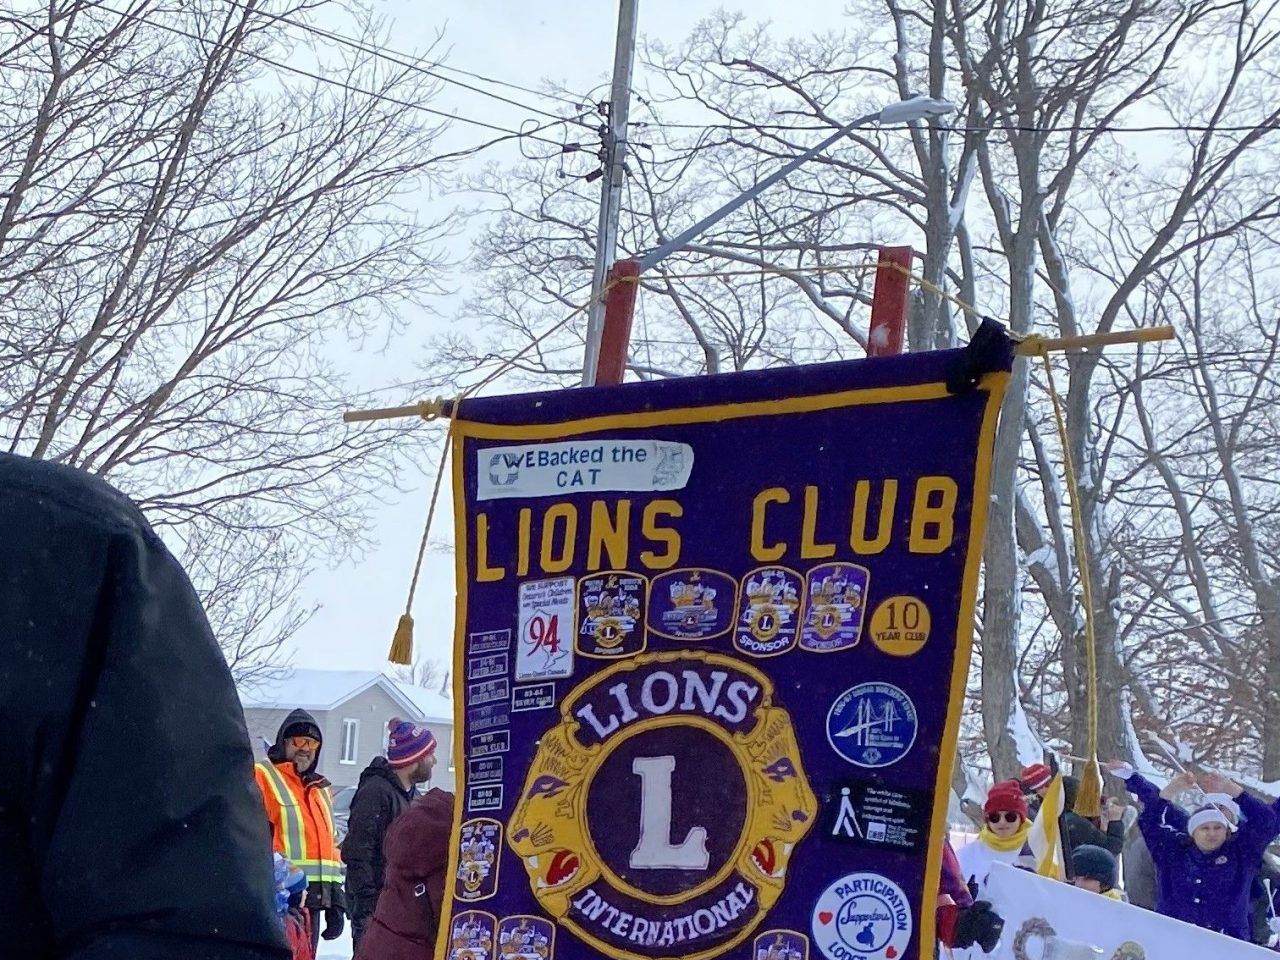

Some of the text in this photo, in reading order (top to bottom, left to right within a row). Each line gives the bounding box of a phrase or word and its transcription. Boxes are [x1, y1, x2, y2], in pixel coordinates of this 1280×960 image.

[538, 446, 602, 466] Backed
[612, 446, 647, 462] the
[557, 469, 601, 487] CAT
[475, 476, 959, 583] LIONS CLUB
[762, 616, 770, 630] L
[885, 602, 920, 630] 10
[527, 614, 560, 657] 94
[740, 635, 789, 652] SPONSOR
[876, 631, 900, 641] YEAR
[576, 669, 759, 739] LIONS
[630, 755, 710, 870] L
[573, 881, 755, 947] INTERNATIONAL
[834, 878, 908, 931] PARTICIPATION
